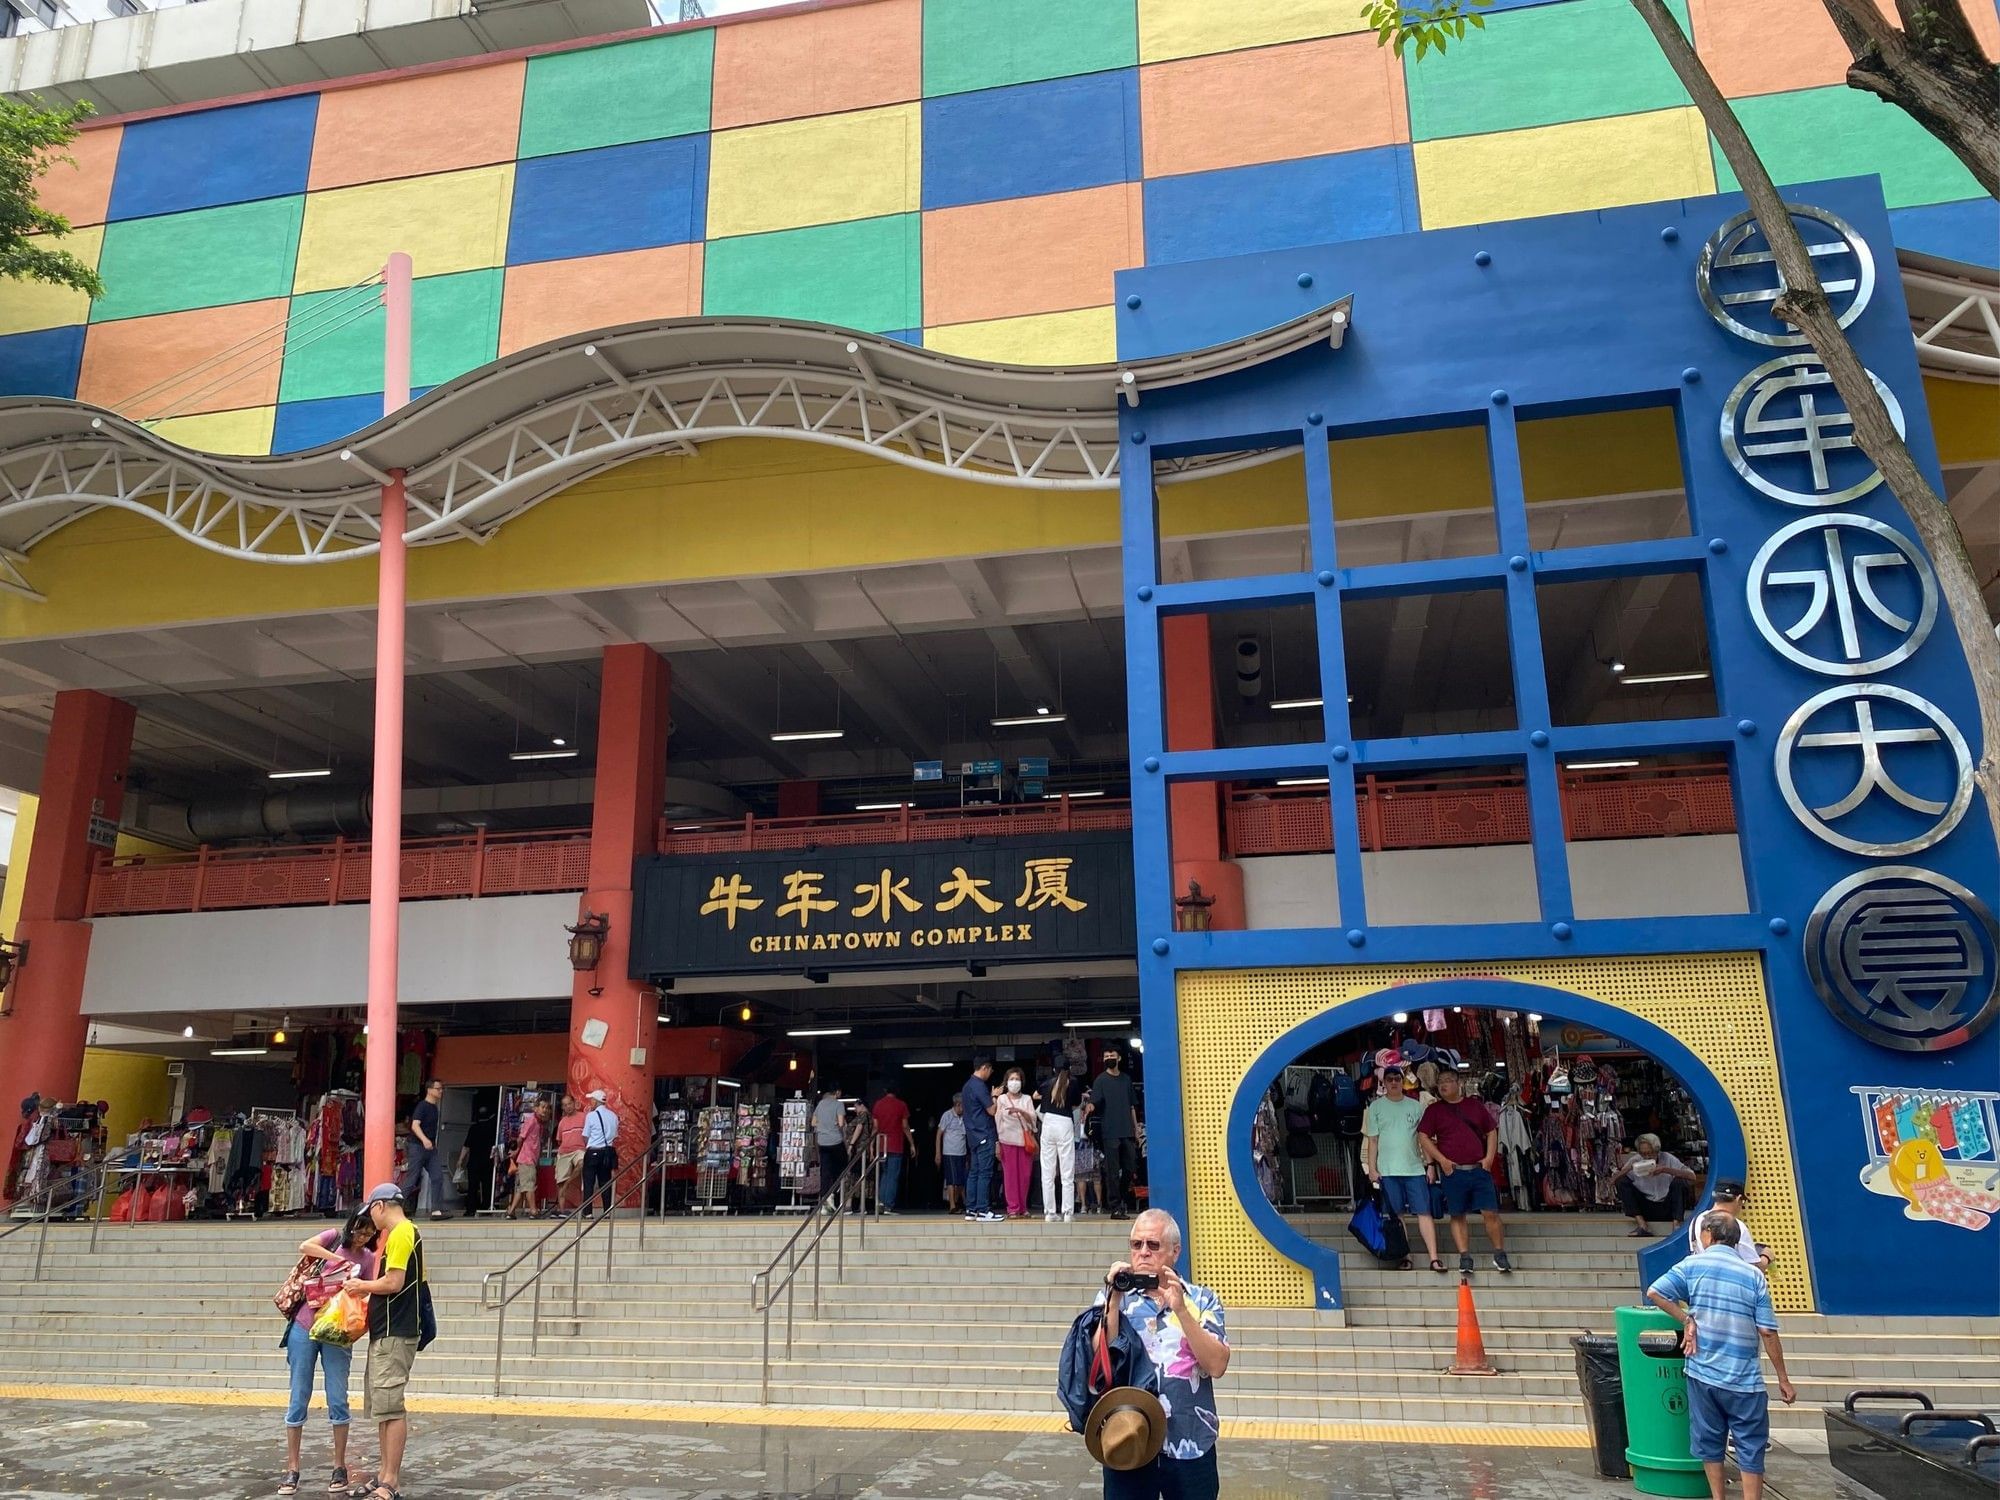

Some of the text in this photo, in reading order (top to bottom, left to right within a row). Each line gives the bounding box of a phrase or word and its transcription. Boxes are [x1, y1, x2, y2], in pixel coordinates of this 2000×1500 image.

[699, 856, 1088, 931] 牛车水大厦
[749, 924, 1033, 953] CHINATOWN COMPLEX
